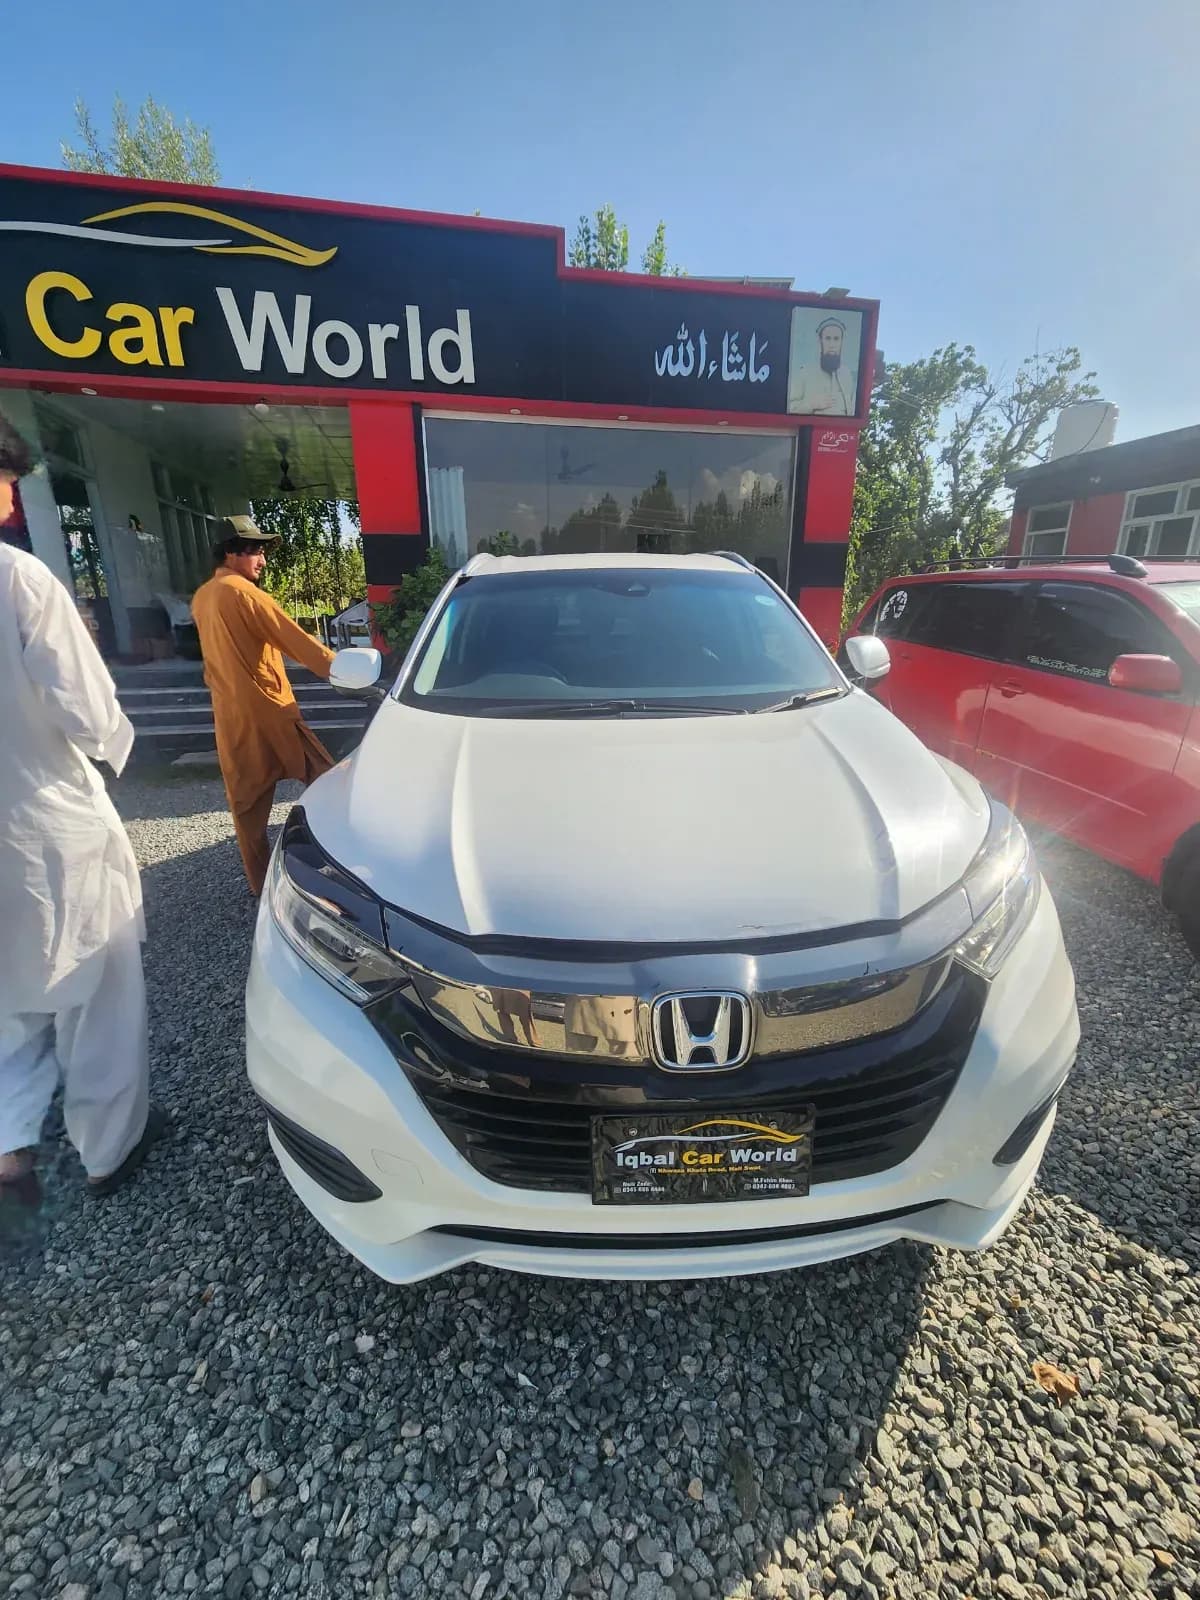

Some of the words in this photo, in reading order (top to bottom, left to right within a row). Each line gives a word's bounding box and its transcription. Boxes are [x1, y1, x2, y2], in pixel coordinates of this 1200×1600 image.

[25, 271, 195, 367] Car
[215, 286, 476, 384] World
[616, 1151, 675, 1169] Iqbal
[682, 1150, 724, 1165] Car
[730, 1148, 797, 1164] World
